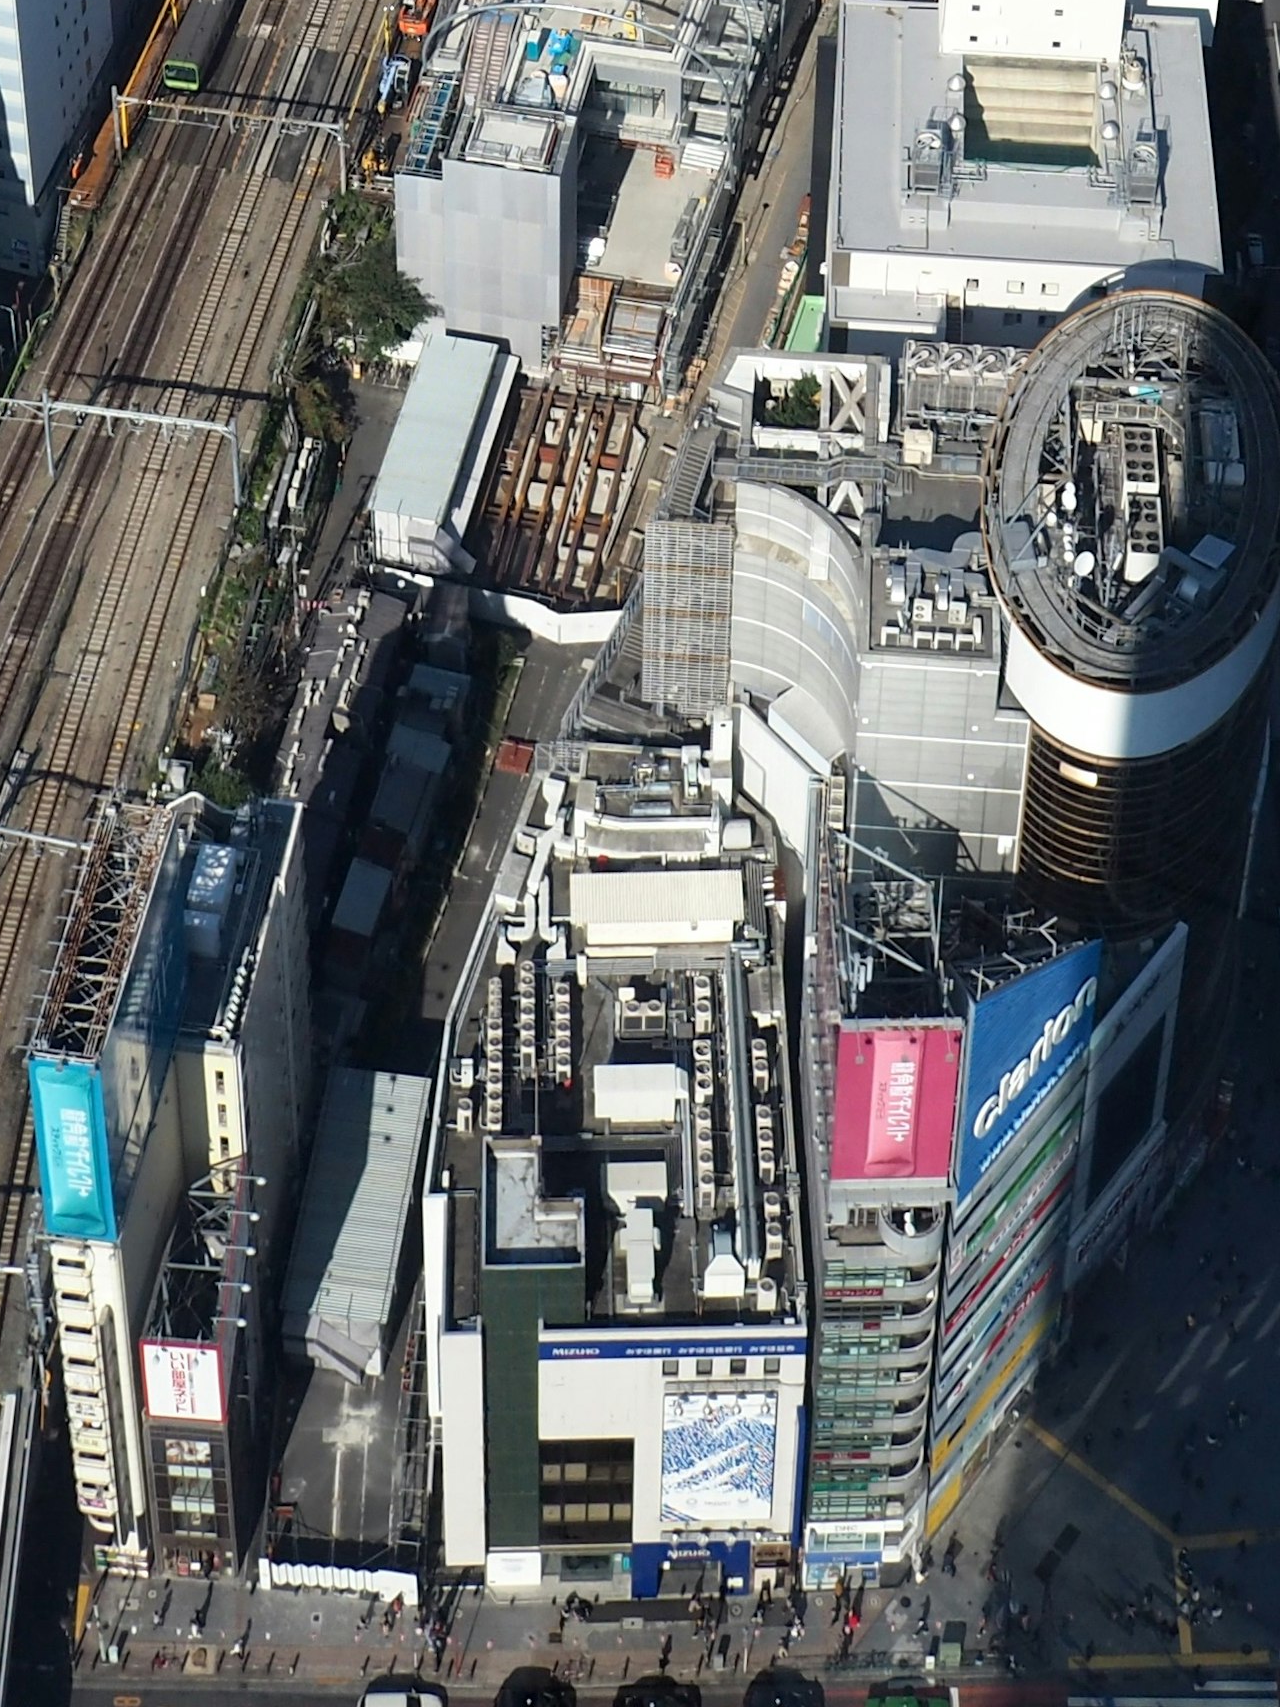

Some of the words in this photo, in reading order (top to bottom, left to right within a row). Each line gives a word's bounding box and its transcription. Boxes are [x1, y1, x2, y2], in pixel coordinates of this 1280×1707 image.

[973, 976, 1097, 1138] Clarion
[552, 1348, 600, 1356] MIZUHO
[625, 1347, 672, 1355] みずほ銀行
[169, 1350, 188, 1414] いい部屋ネット
[835, 1525, 858, 1533] DHC
[666, 1549, 712, 1559] MIZUHO
